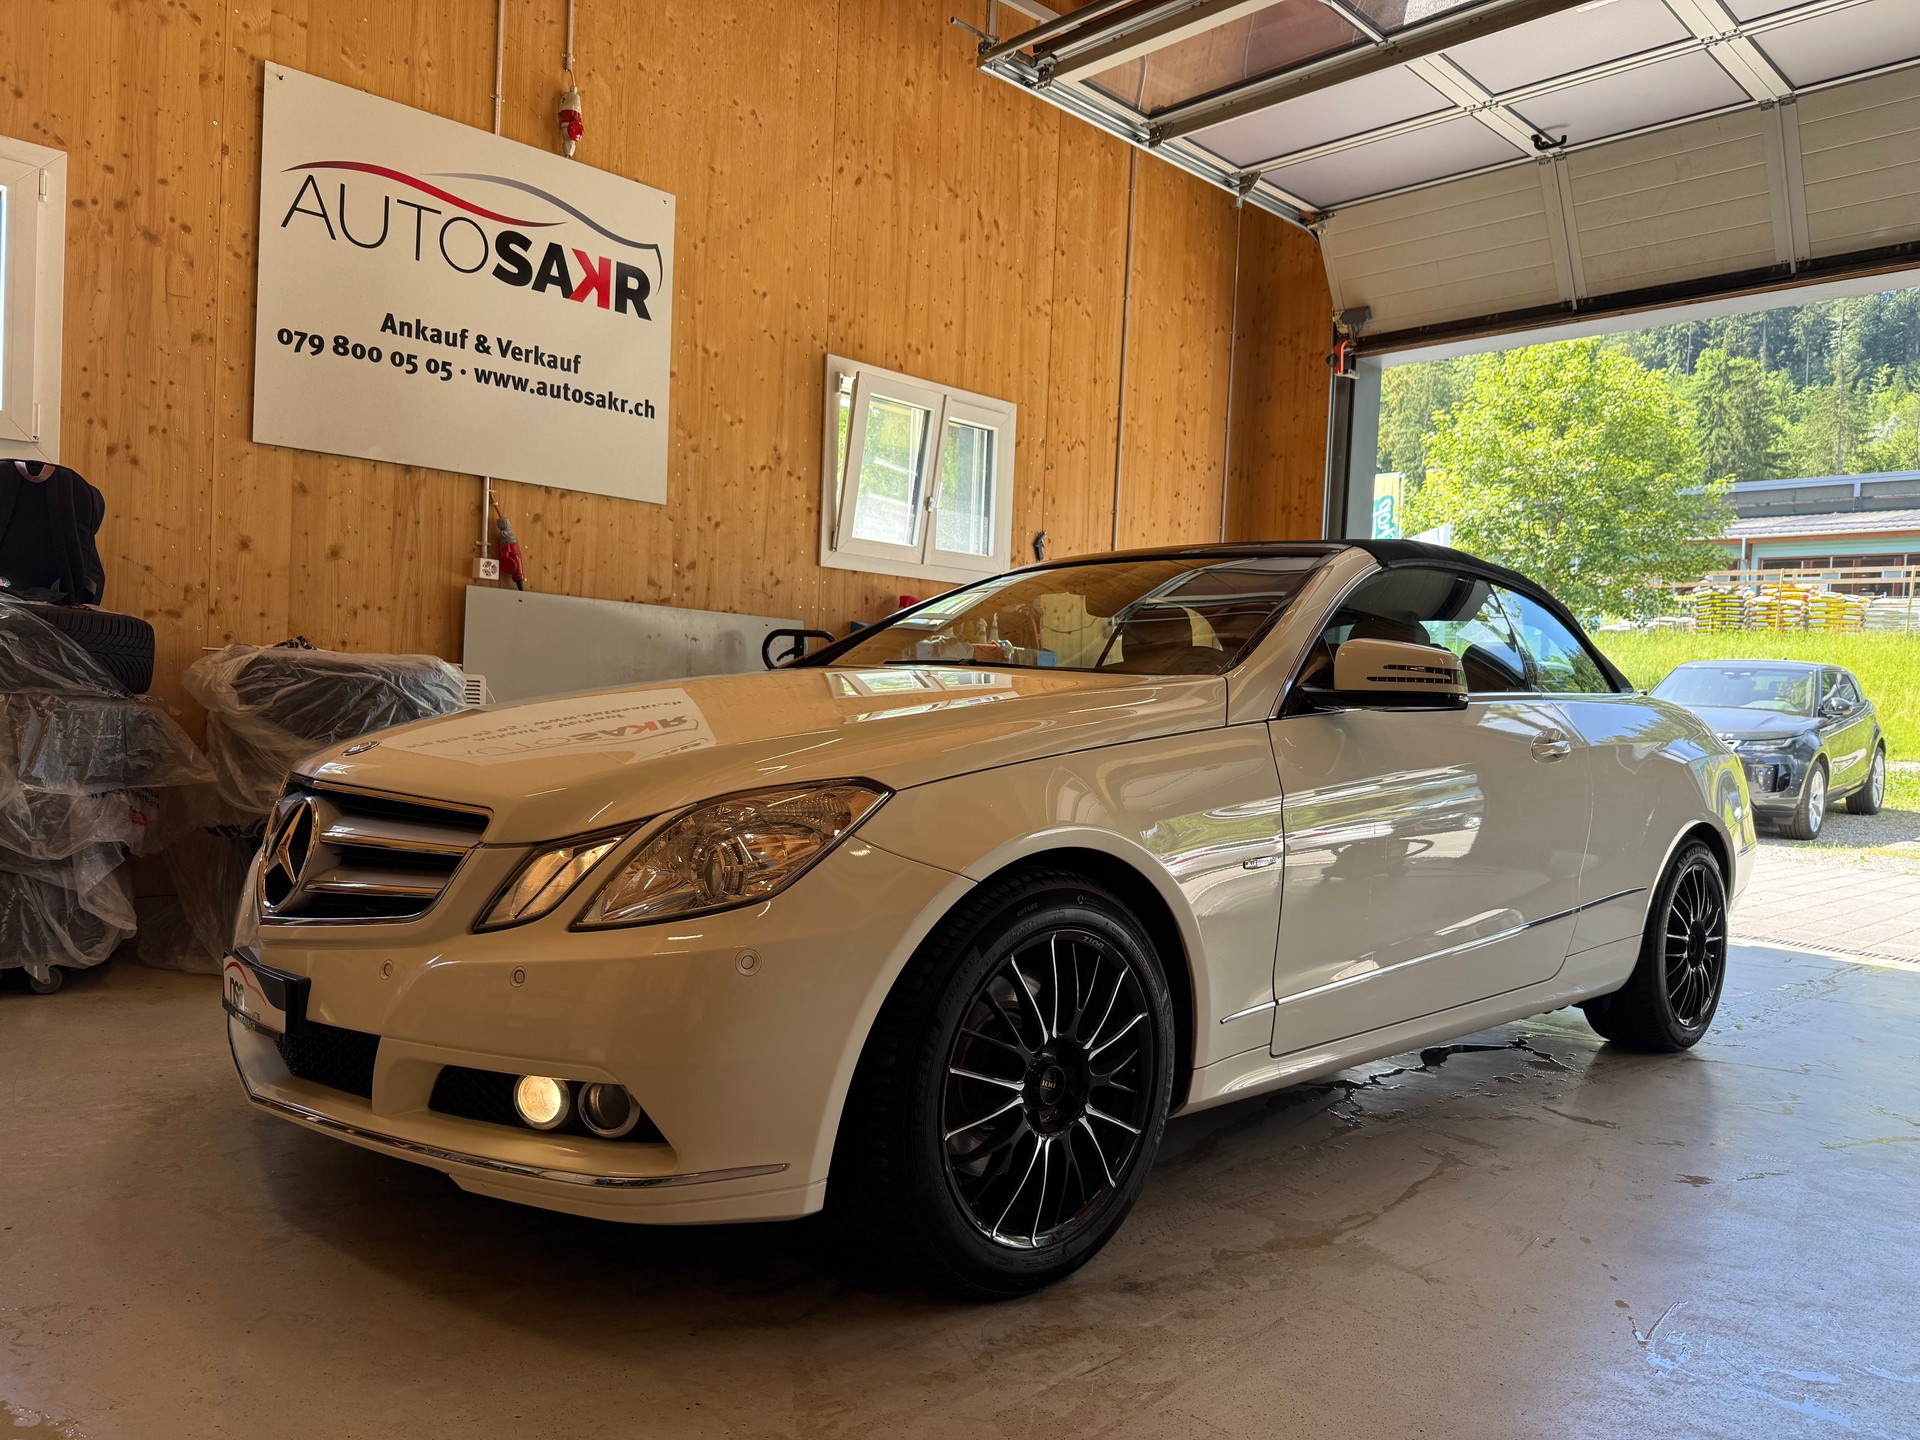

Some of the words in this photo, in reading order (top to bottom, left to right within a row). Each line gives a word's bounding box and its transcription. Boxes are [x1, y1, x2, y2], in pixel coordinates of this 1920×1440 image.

[281, 174, 652, 322] AUTOSAKR
[277, 328, 325, 356] 079
[332, 335, 383, 364] 800
[389, 351, 419, 375] 05
[425, 358, 453, 382] 05
[474, 367, 656, 420] www.autosakr.ch
[380, 313, 469, 350] Ankauf
[474, 333, 493, 356] &
[496, 337, 582, 376] Verkauf
